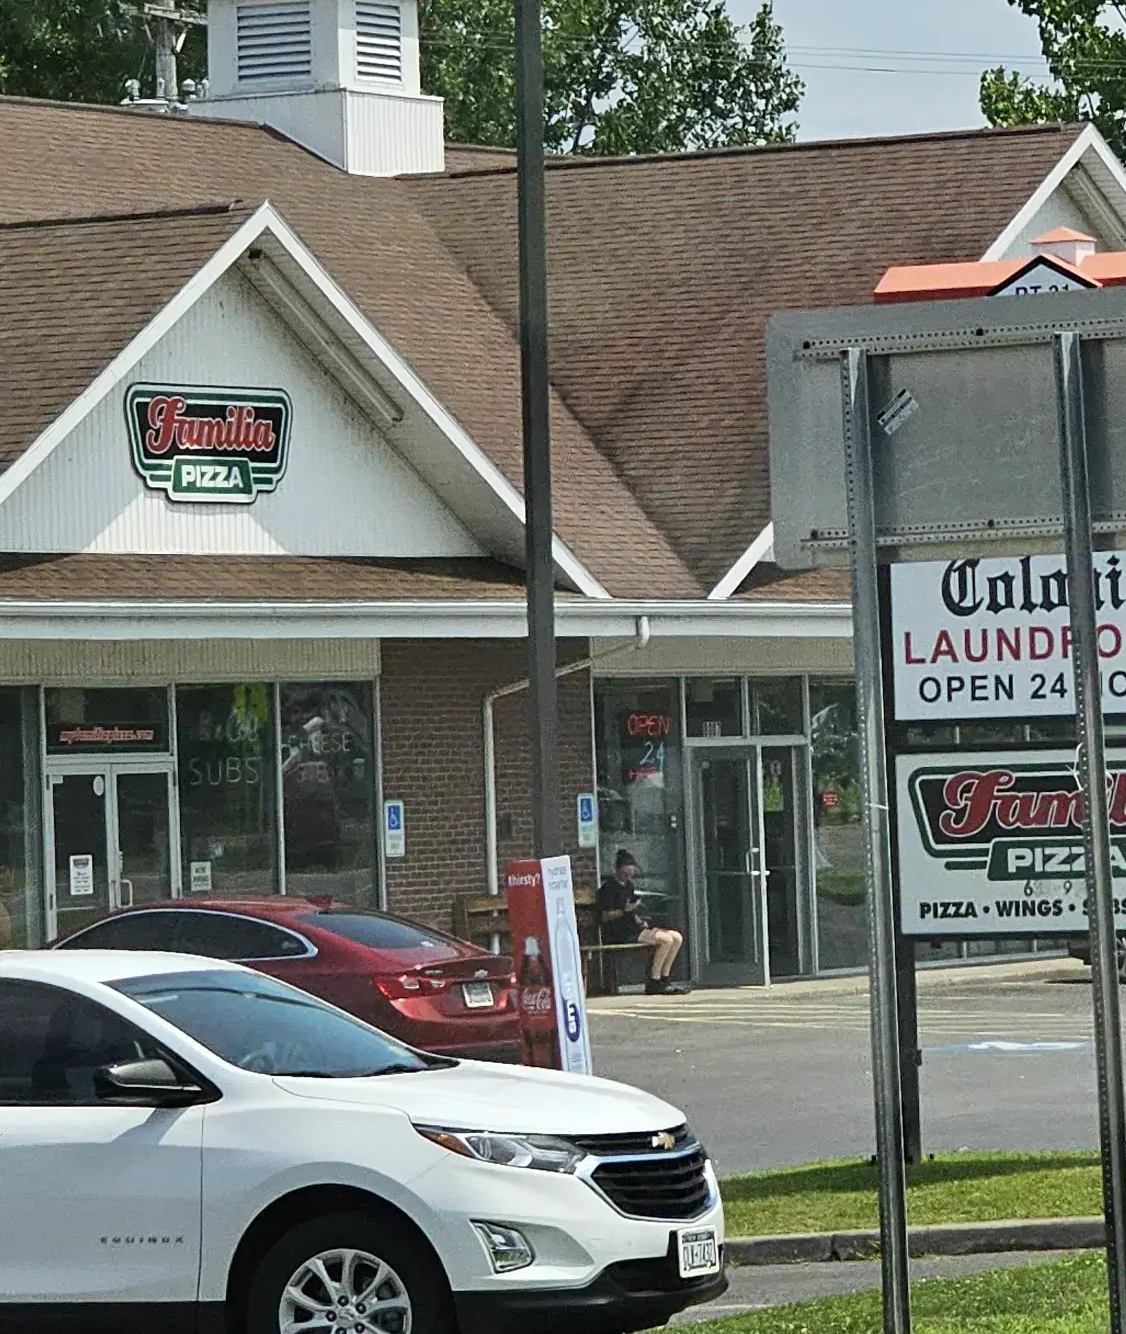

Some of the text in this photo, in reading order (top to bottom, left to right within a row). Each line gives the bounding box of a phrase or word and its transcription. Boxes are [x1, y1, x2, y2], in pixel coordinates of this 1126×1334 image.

[146, 396, 276, 454] Familia
[181, 464, 244, 488] PIZZA
[919, 673, 1014, 703] OPEN
[1030, 672, 1068, 700] 24
[628, 713, 670, 736] OPEN
[640, 741, 665, 773] 24
[188, 756, 261, 786] SUBS
[508, 872, 541, 887] thirsty?
[919, 901, 978, 919] PIZZA
[995, 899, 1064, 918] WINGS
